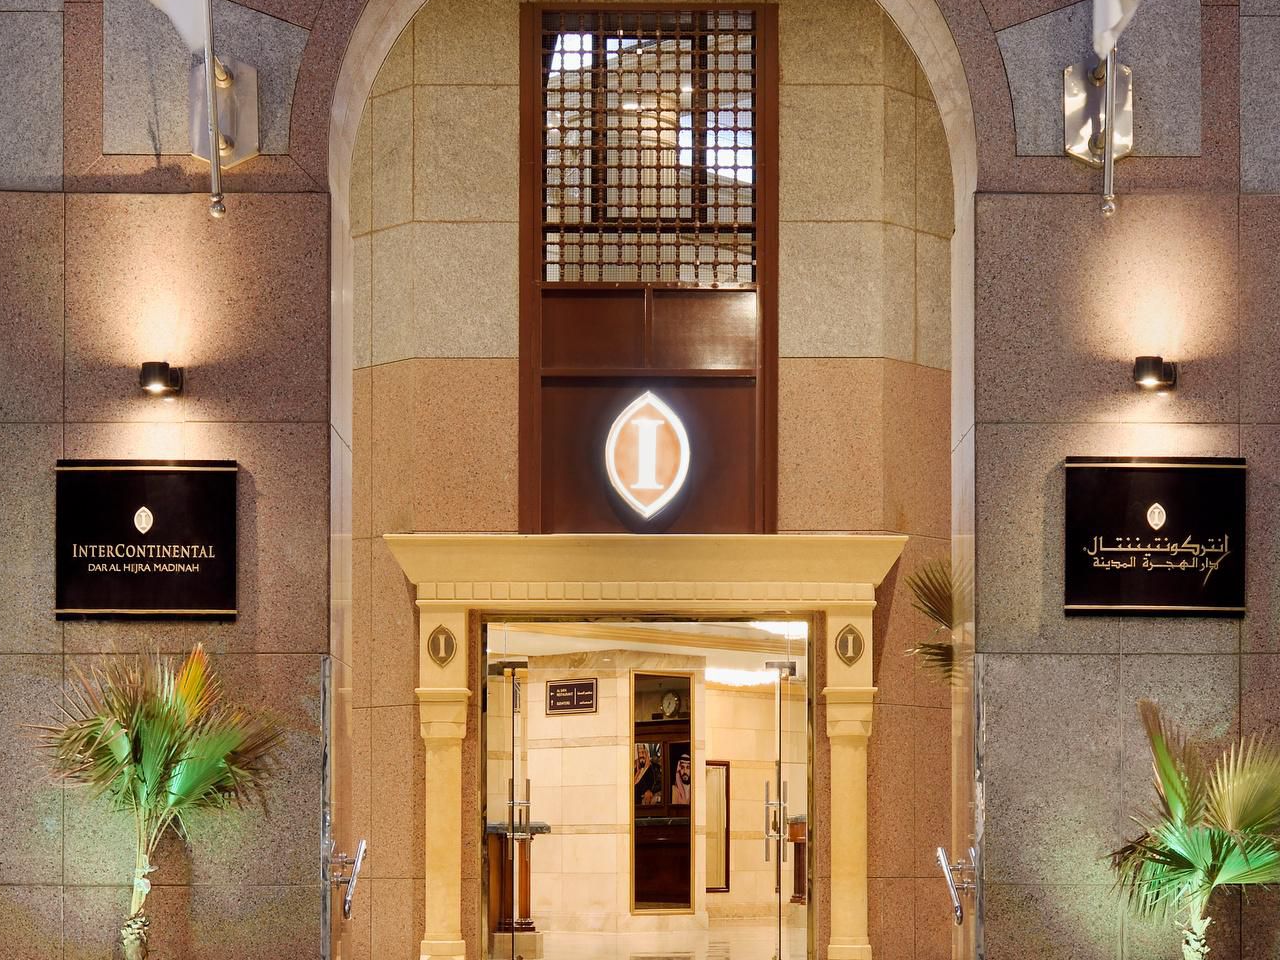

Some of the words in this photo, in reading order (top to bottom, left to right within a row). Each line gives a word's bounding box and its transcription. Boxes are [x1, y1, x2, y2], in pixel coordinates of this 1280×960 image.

[72, 543, 216, 558] INTERCONTINENTAL
[88, 563, 108, 572] DAR
[109, 563, 121, 572] AL
[123, 563, 151, 574] HIJRA
[153, 563, 200, 572] MADINAH
[1093, 556, 1136, 570] المدينة
[1142, 556, 1199, 571] الهجرة
